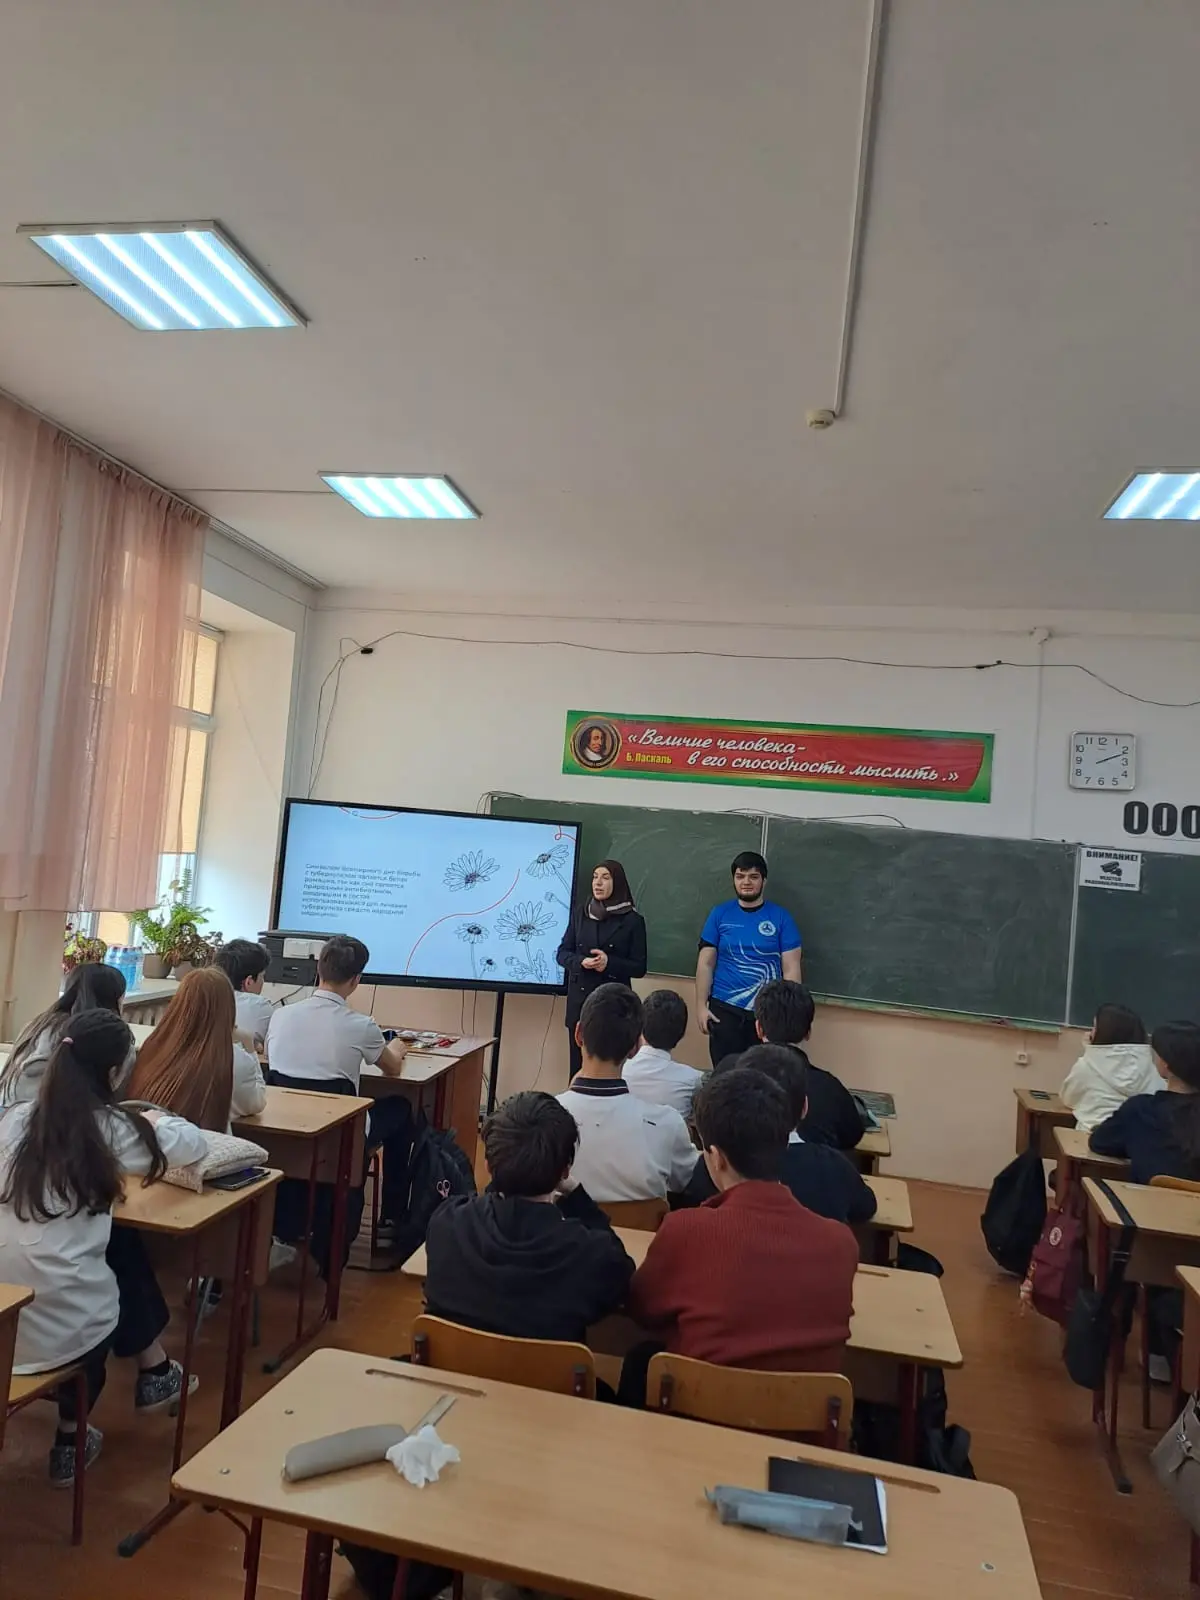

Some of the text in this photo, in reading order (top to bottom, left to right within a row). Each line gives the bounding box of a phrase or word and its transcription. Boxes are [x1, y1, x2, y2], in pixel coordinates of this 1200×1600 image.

[628, 728, 806, 754] «Величие человека-
[1098, 737, 1108, 745] 12
[1076, 744, 1084, 752] 10
[1122, 746, 1128, 754] 2
[626, 752, 672, 764] Б. Паскаль
[1076, 756, 1082, 764] 9
[1121, 758, 1128, 766] 3
[687, 751, 700, 765] в
[702, 756, 727, 767] его
[732, 755, 845, 775] способности
[1076, 768, 1082, 776] 8
[1121, 770, 1128, 778] 4
[1084, 776, 1092, 784] 7
[1098, 777, 1104, 786] 6
[1112, 778, 1118, 786] 5
[1086, 850, 1138, 861] ВНИМАНИЕ!
